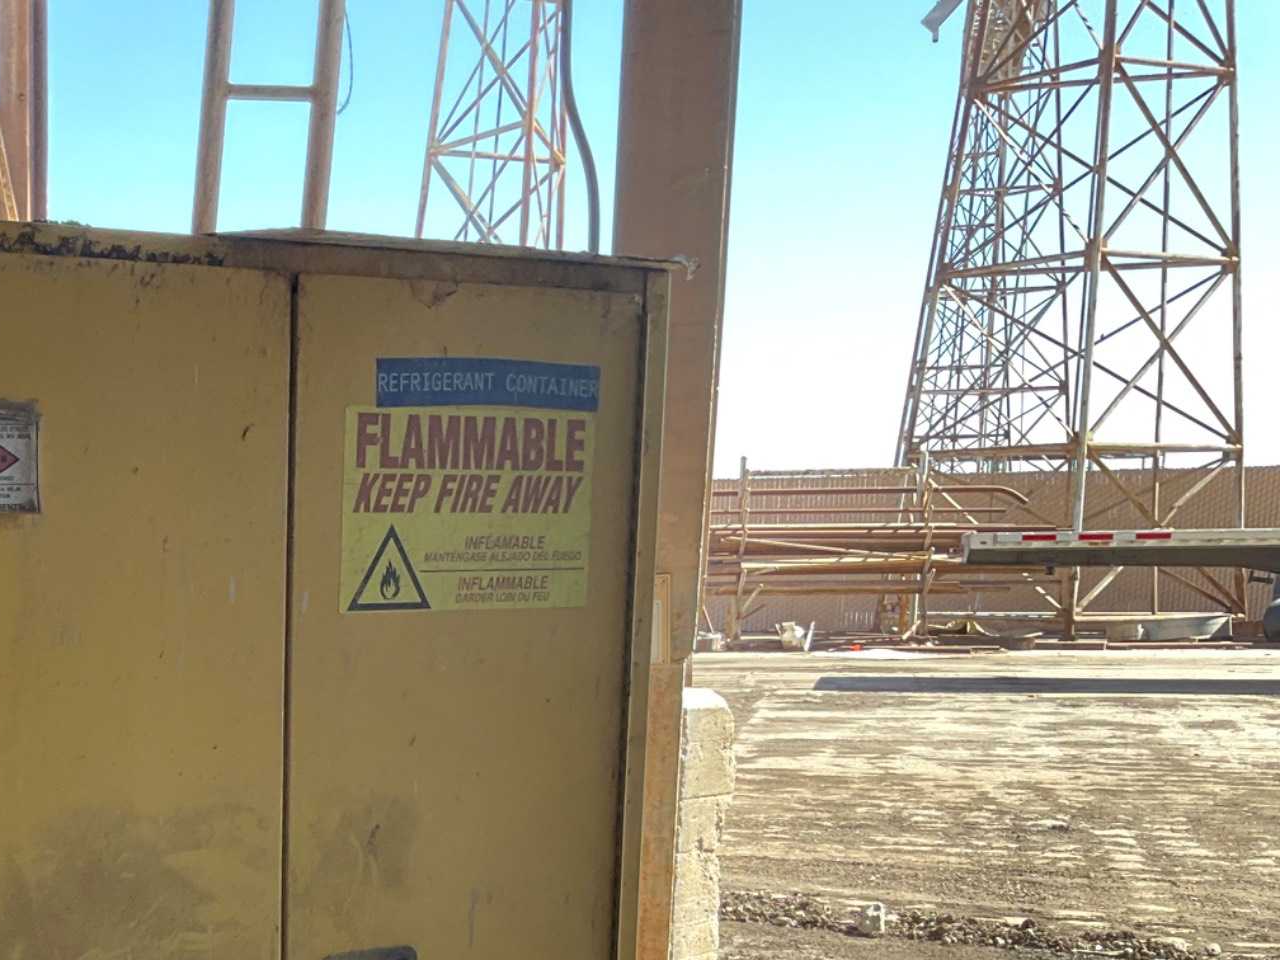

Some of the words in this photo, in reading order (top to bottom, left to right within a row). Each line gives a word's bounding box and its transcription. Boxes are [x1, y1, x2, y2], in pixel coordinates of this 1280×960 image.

[377, 371, 495, 393] REFRIGERANT
[505, 373, 599, 398] CONTAINER
[355, 412, 586, 473] FLAMMABLE
[352, 472, 432, 514] KEEP
[433, 474, 501, 514] FIRE
[501, 475, 583, 515] AWAY
[464, 535, 546, 550] INFLAMABLE
[488, 551, 531, 562] ALEJADO
[532, 551, 549, 561] DEL
[457, 575, 549, 591] INFLAMMABLE
[532, 591, 550, 602] FEU
